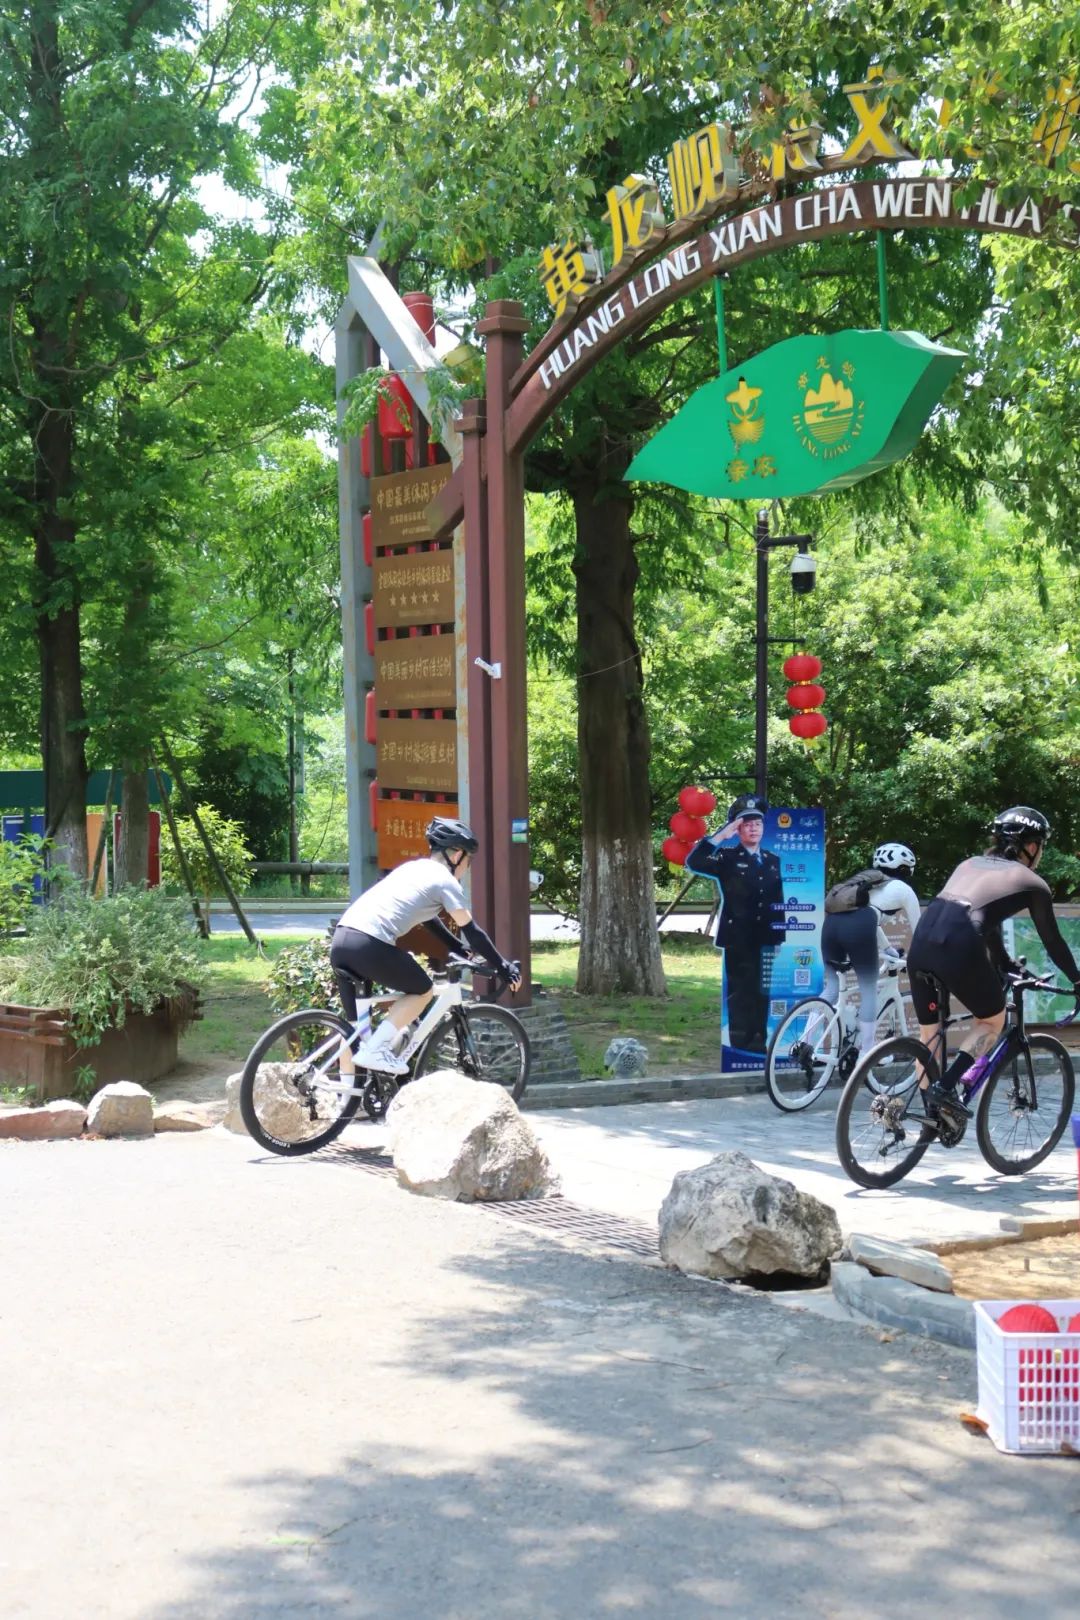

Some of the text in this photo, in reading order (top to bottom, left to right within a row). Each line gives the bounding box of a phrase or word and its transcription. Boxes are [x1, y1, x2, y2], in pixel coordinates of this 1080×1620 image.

[538, 287, 625, 390] HUANG
[628, 240, 702, 310] LONG
[709, 203, 783, 259] XIAN
[794, 188, 863, 232] CHA
[872, 181, 951, 218] WEN
[385, 818, 428, 839] 全国民主法
